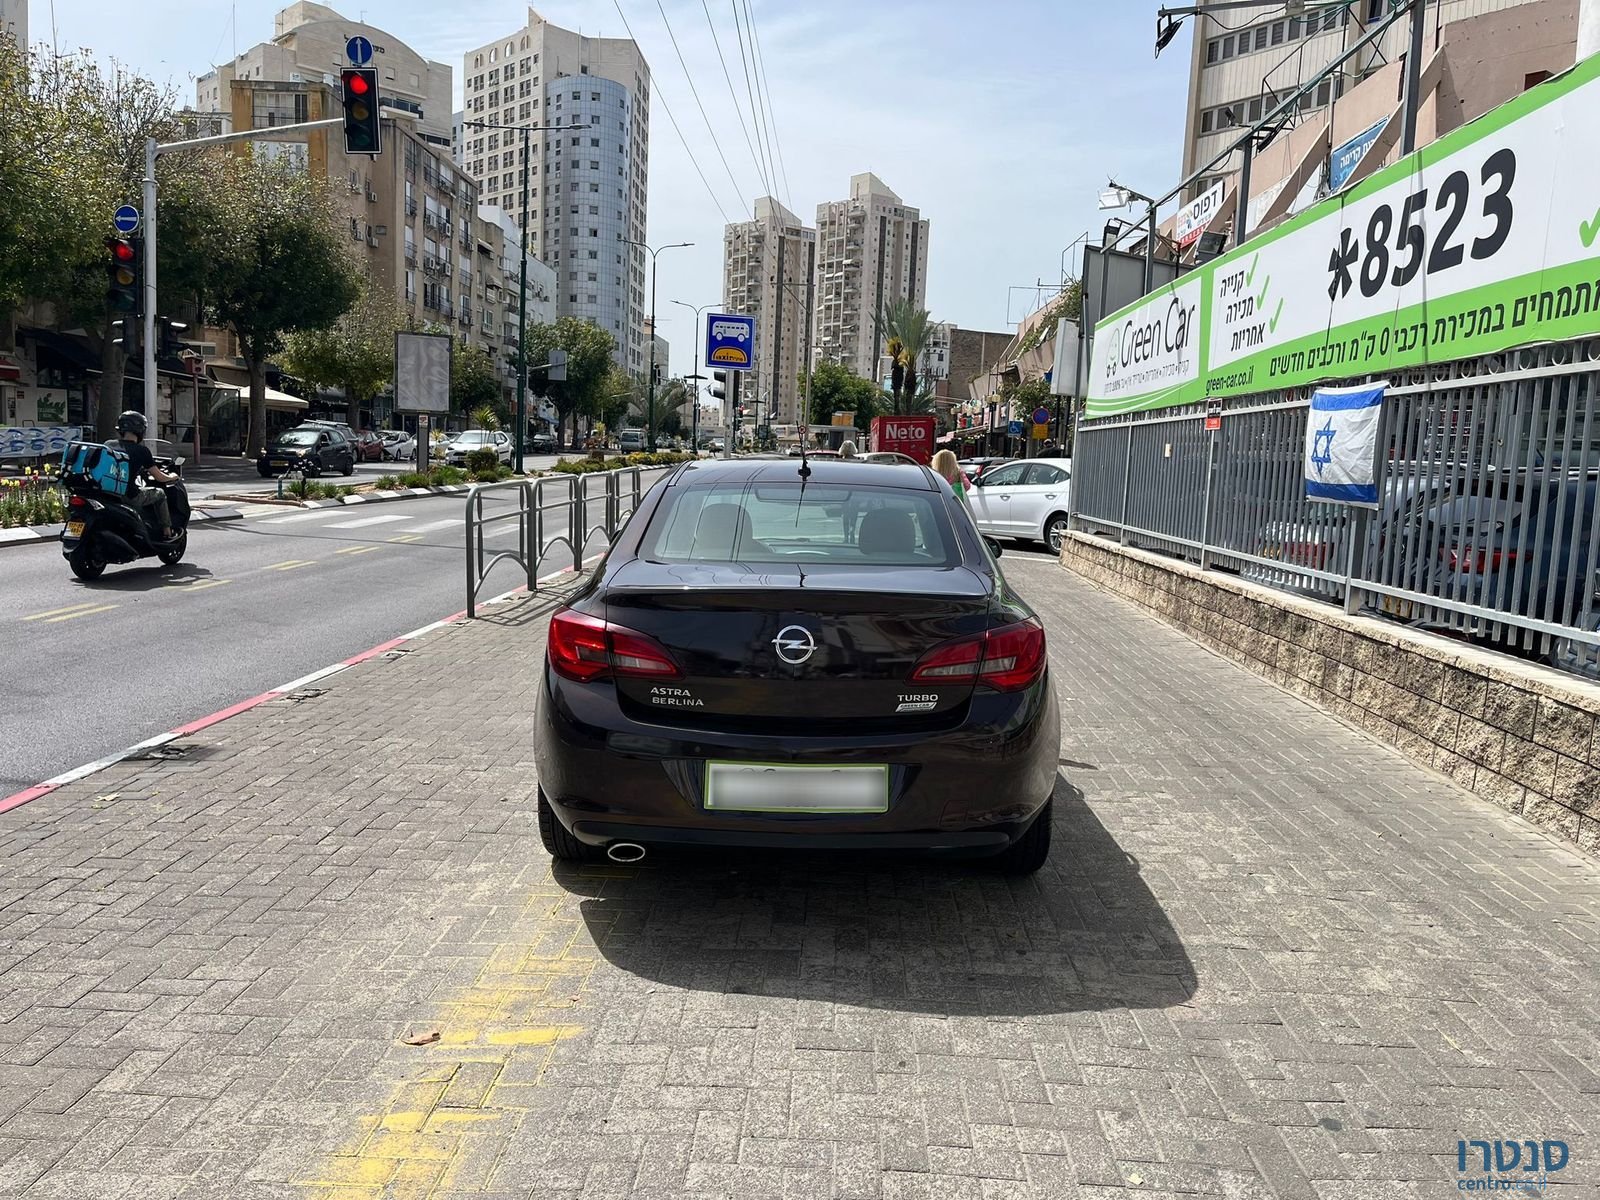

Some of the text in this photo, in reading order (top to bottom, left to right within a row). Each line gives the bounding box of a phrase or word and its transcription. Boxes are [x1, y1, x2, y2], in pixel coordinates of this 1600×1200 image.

[1193, 189, 1218, 220] דפוס
[1220, 270, 1245, 298] קנייה
[1225, 295, 1254, 324] מכירה
[1121, 297, 1196, 368] Green Car
[1230, 322, 1266, 352] אחריות
[1394, 322, 1428, 353] רכבי
[1432, 303, 1505, 345] במכירת
[1269, 351, 1305, 377] חדשים
[1307, 341, 1347, 369] ורכבים
[1205, 365, 1255, 396] green-car.co.il
[885, 423, 926, 440] Neto
[650, 687, 691, 697] ASTRA
[652, 697, 704, 706] BERLINA
[897, 694, 939, 702] TURBO
